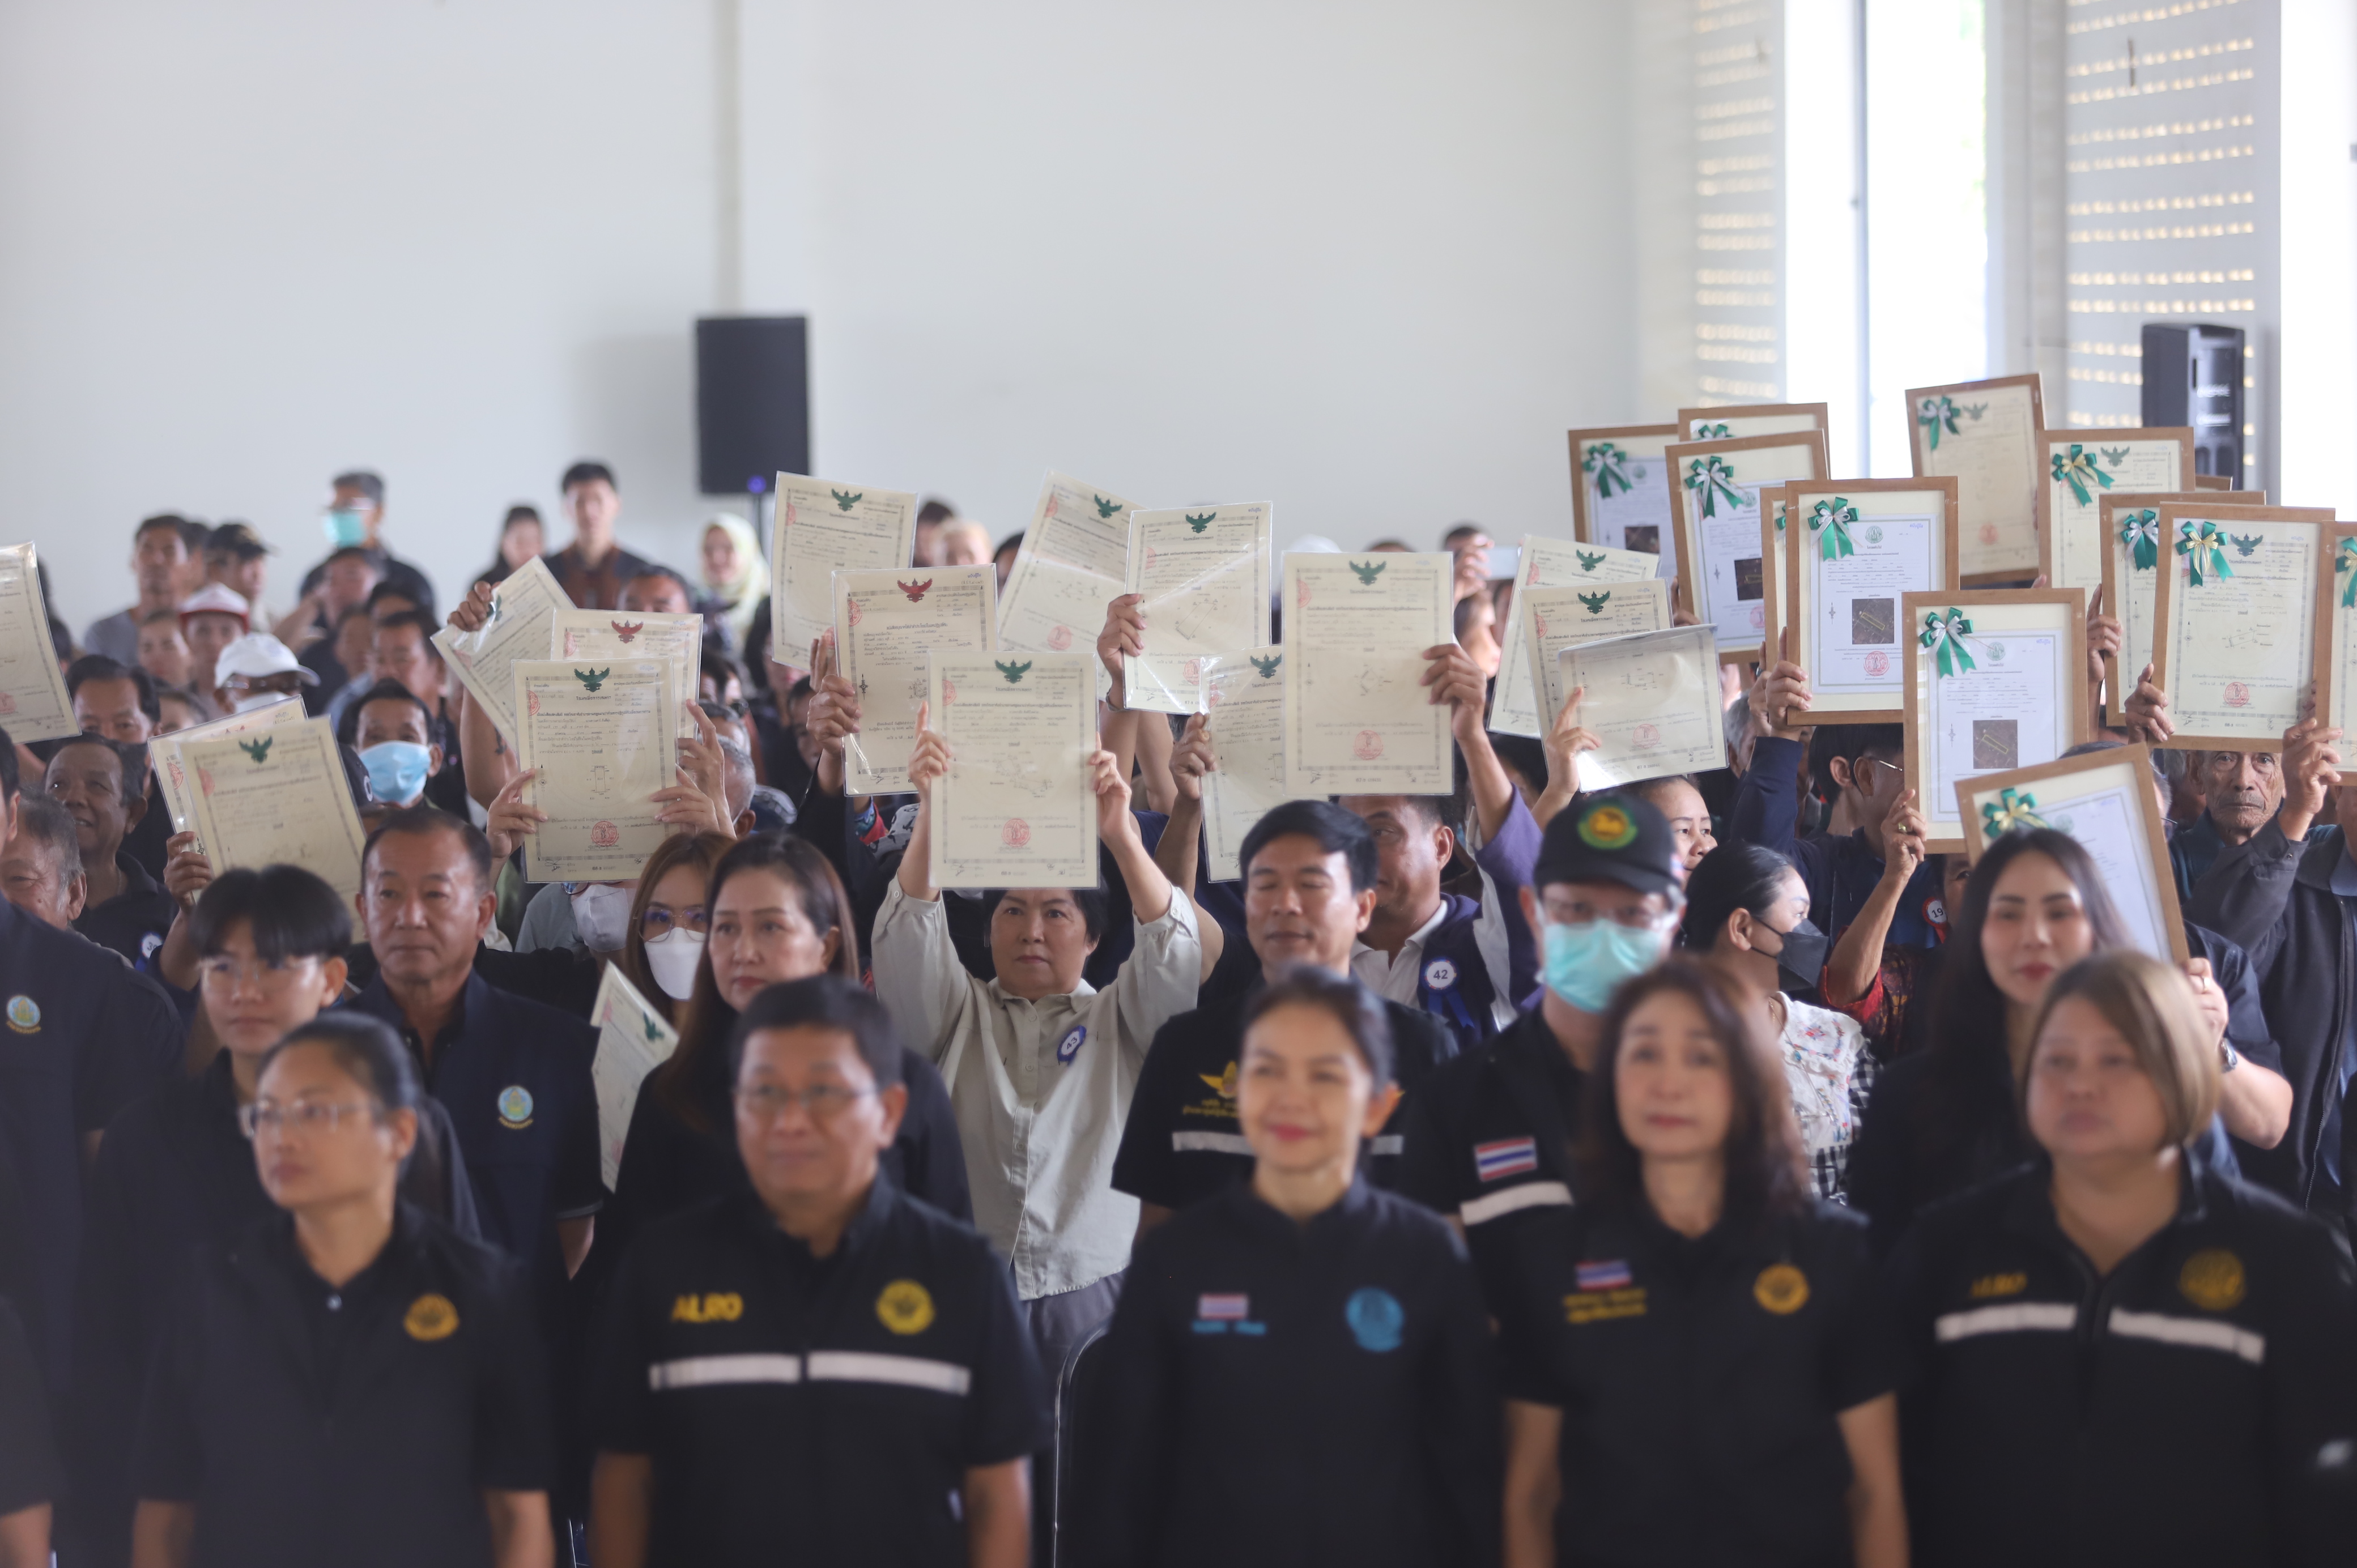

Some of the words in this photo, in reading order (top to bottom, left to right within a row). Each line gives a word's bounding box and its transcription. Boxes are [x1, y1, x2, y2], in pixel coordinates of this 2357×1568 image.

[1931, 908, 1943, 918] 19
[1433, 969, 1448, 979] 42
[1067, 1037, 1078, 1050] 43
